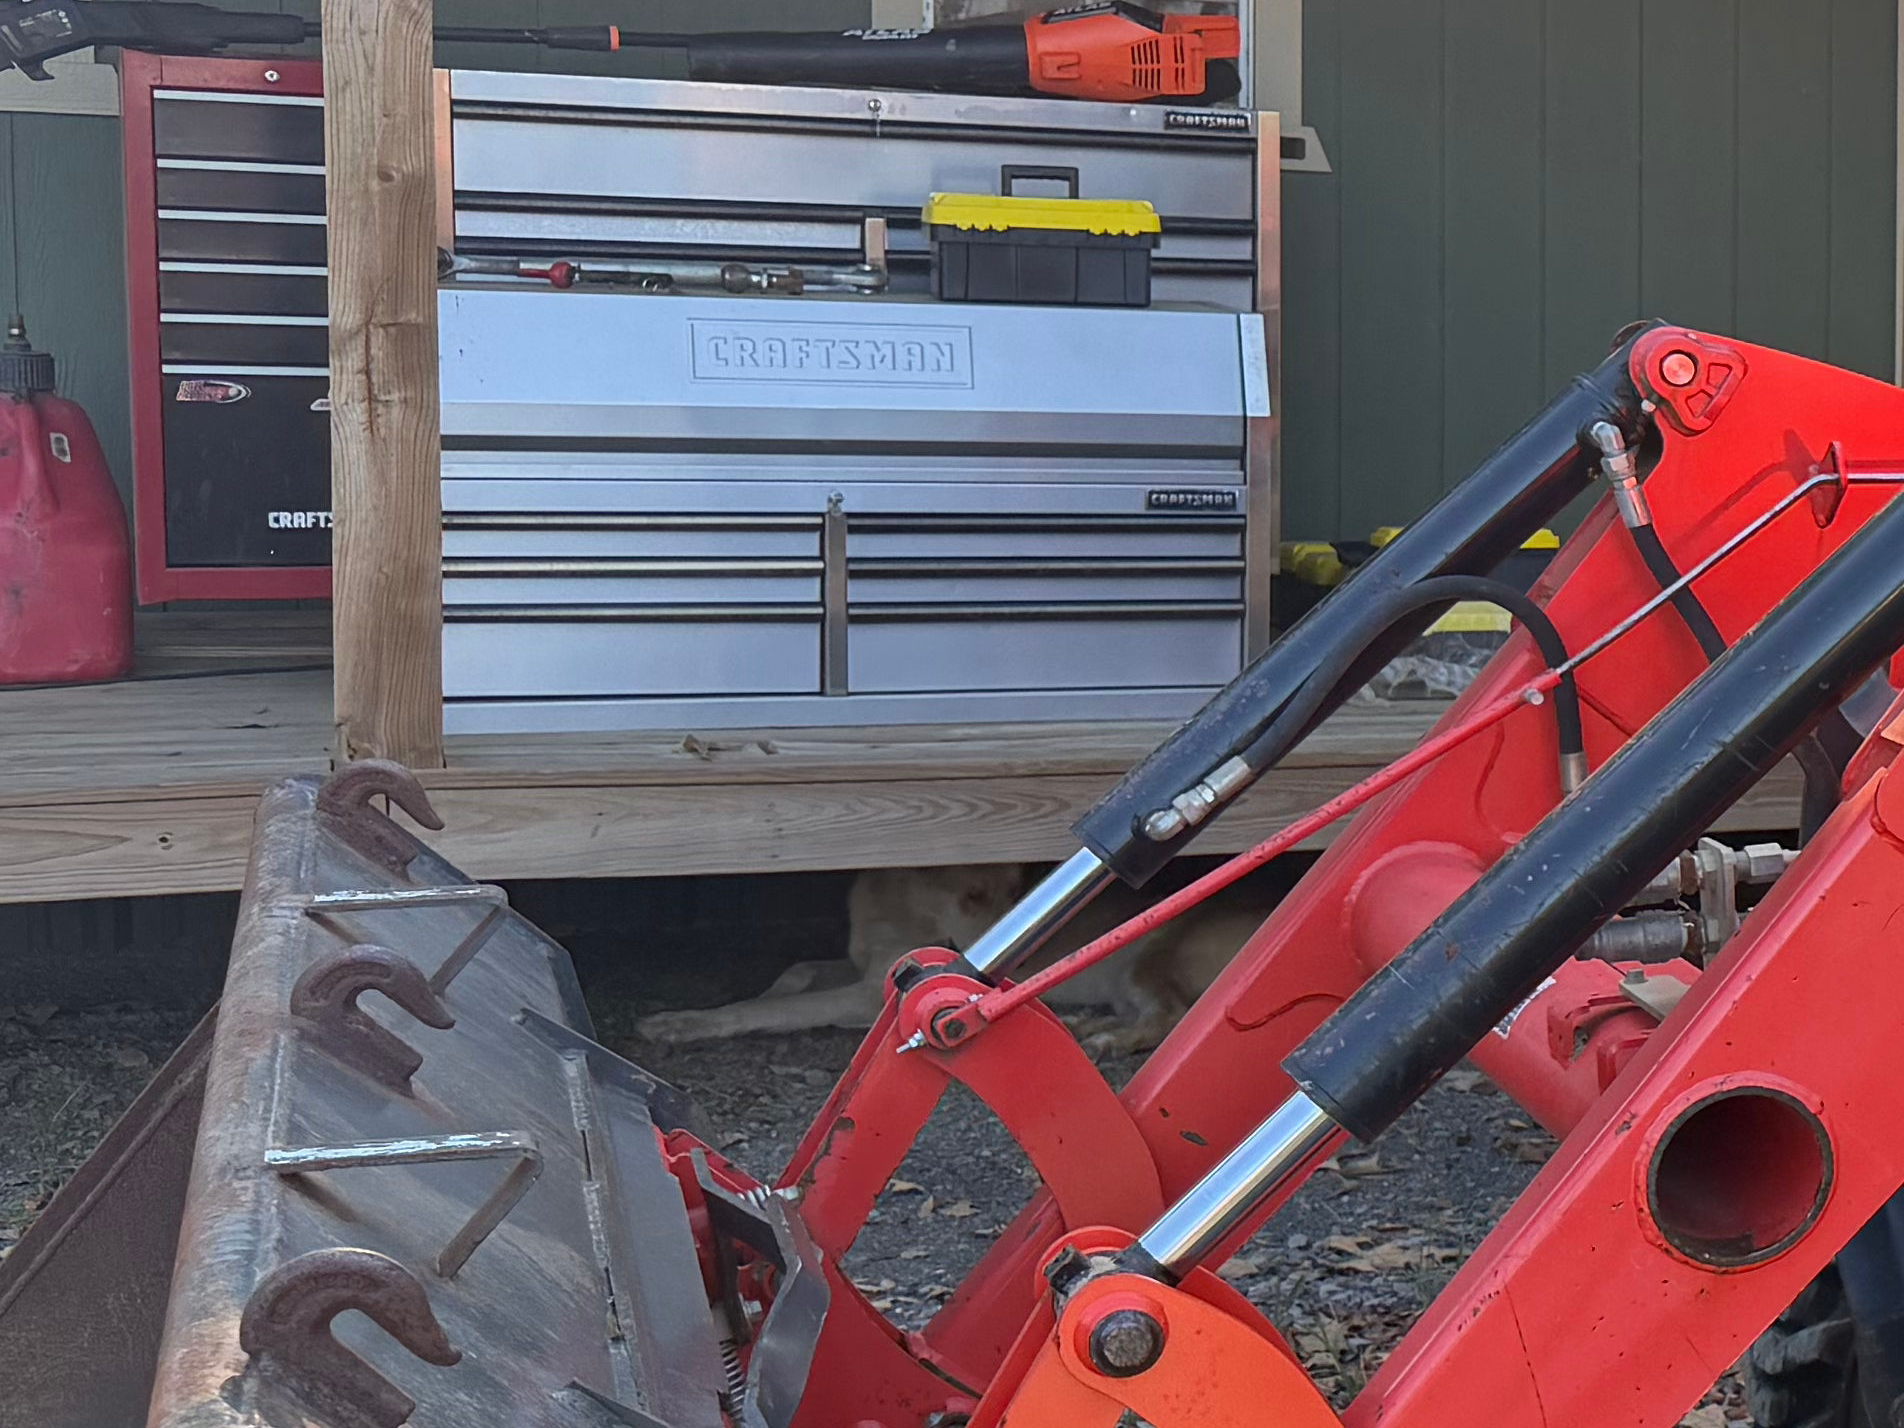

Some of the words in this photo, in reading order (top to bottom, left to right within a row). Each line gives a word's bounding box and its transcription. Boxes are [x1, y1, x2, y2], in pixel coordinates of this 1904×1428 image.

[1166, 113, 1249, 130] CRAFTSMAN
[706, 334, 957, 374] CRAFTSMAN
[1149, 490, 1237, 509] CRAFTSMAN
